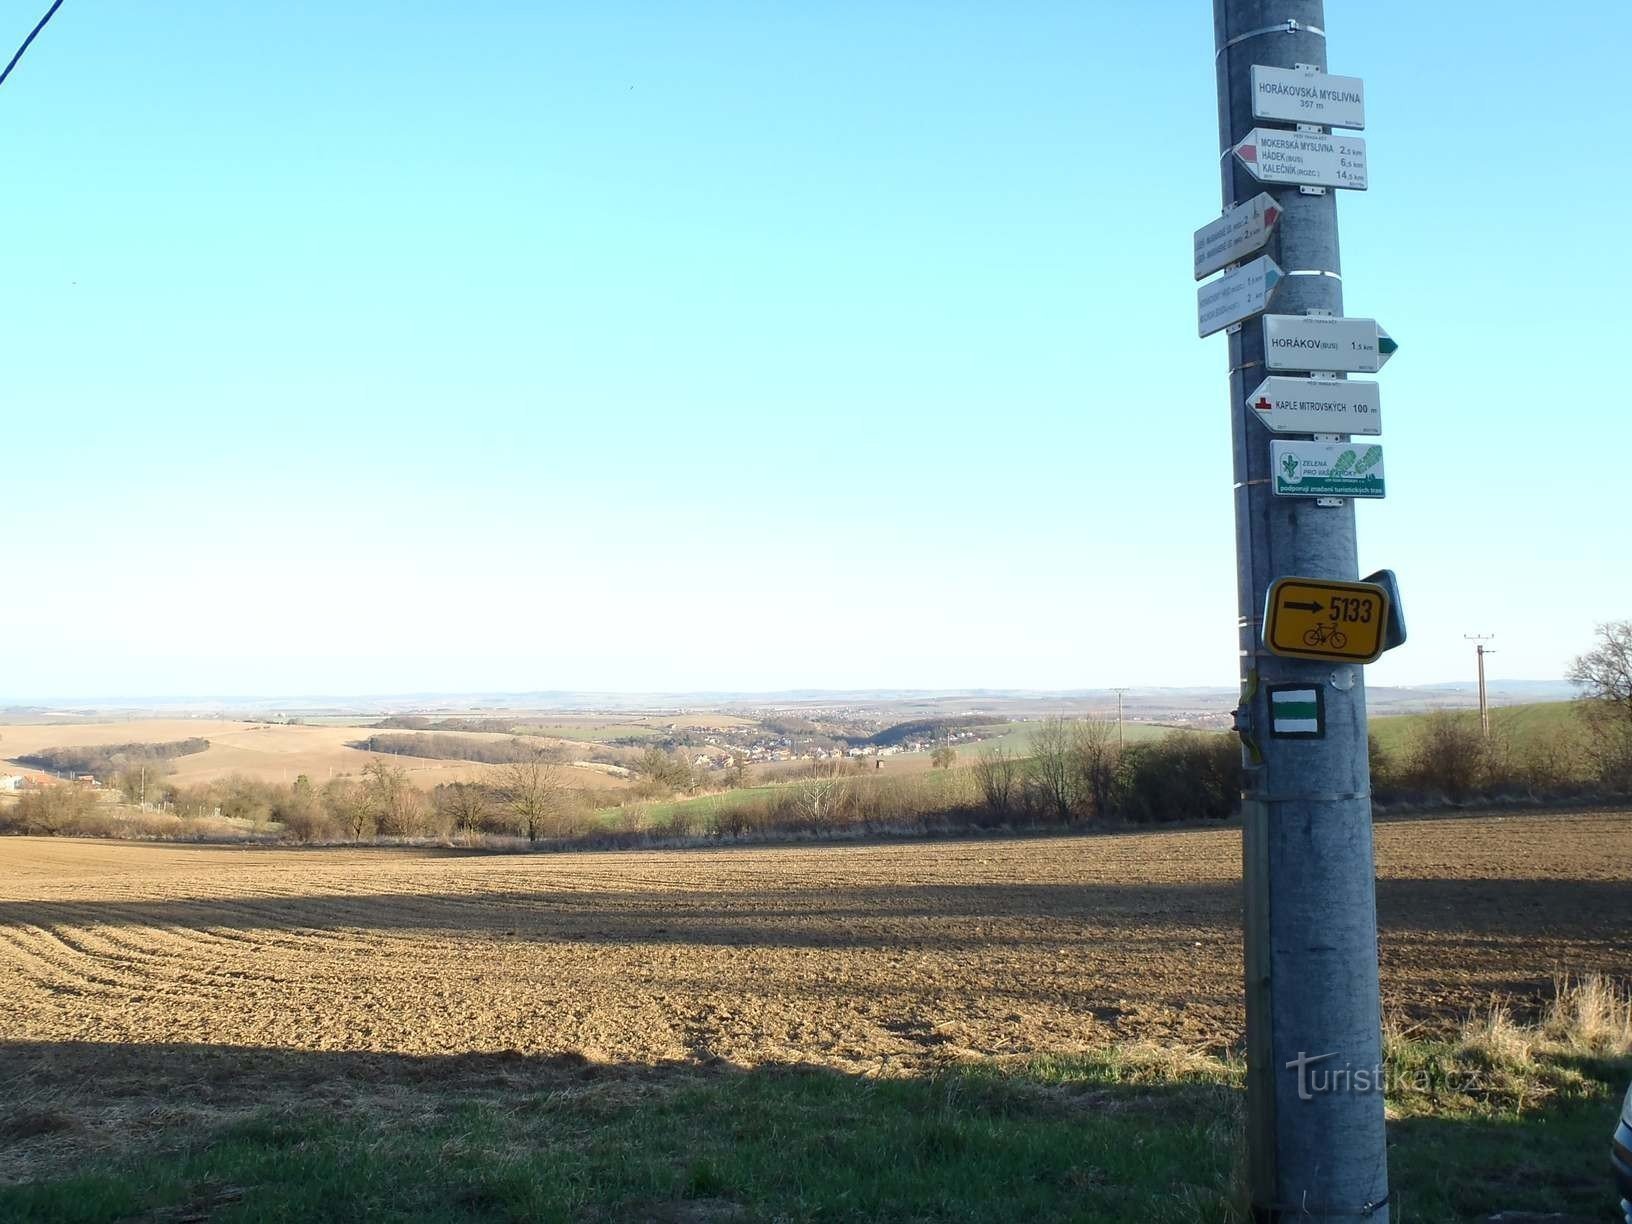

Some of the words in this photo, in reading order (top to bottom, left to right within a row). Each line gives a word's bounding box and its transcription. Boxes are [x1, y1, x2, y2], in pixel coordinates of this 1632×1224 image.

[1259, 83, 1318, 98] HORÁKOVSKÁ
[1319, 90, 1361, 103] MYSLIVNA
[1300, 100, 1314, 108] 357
[1300, 142, 1334, 153] MYSLIVNA
[1275, 400, 1297, 411] KAPLE
[1299, 401, 1347, 413] MITROVSKÝCH
[1353, 404, 1368, 414] 100
[1329, 596, 1373, 623] 5133
